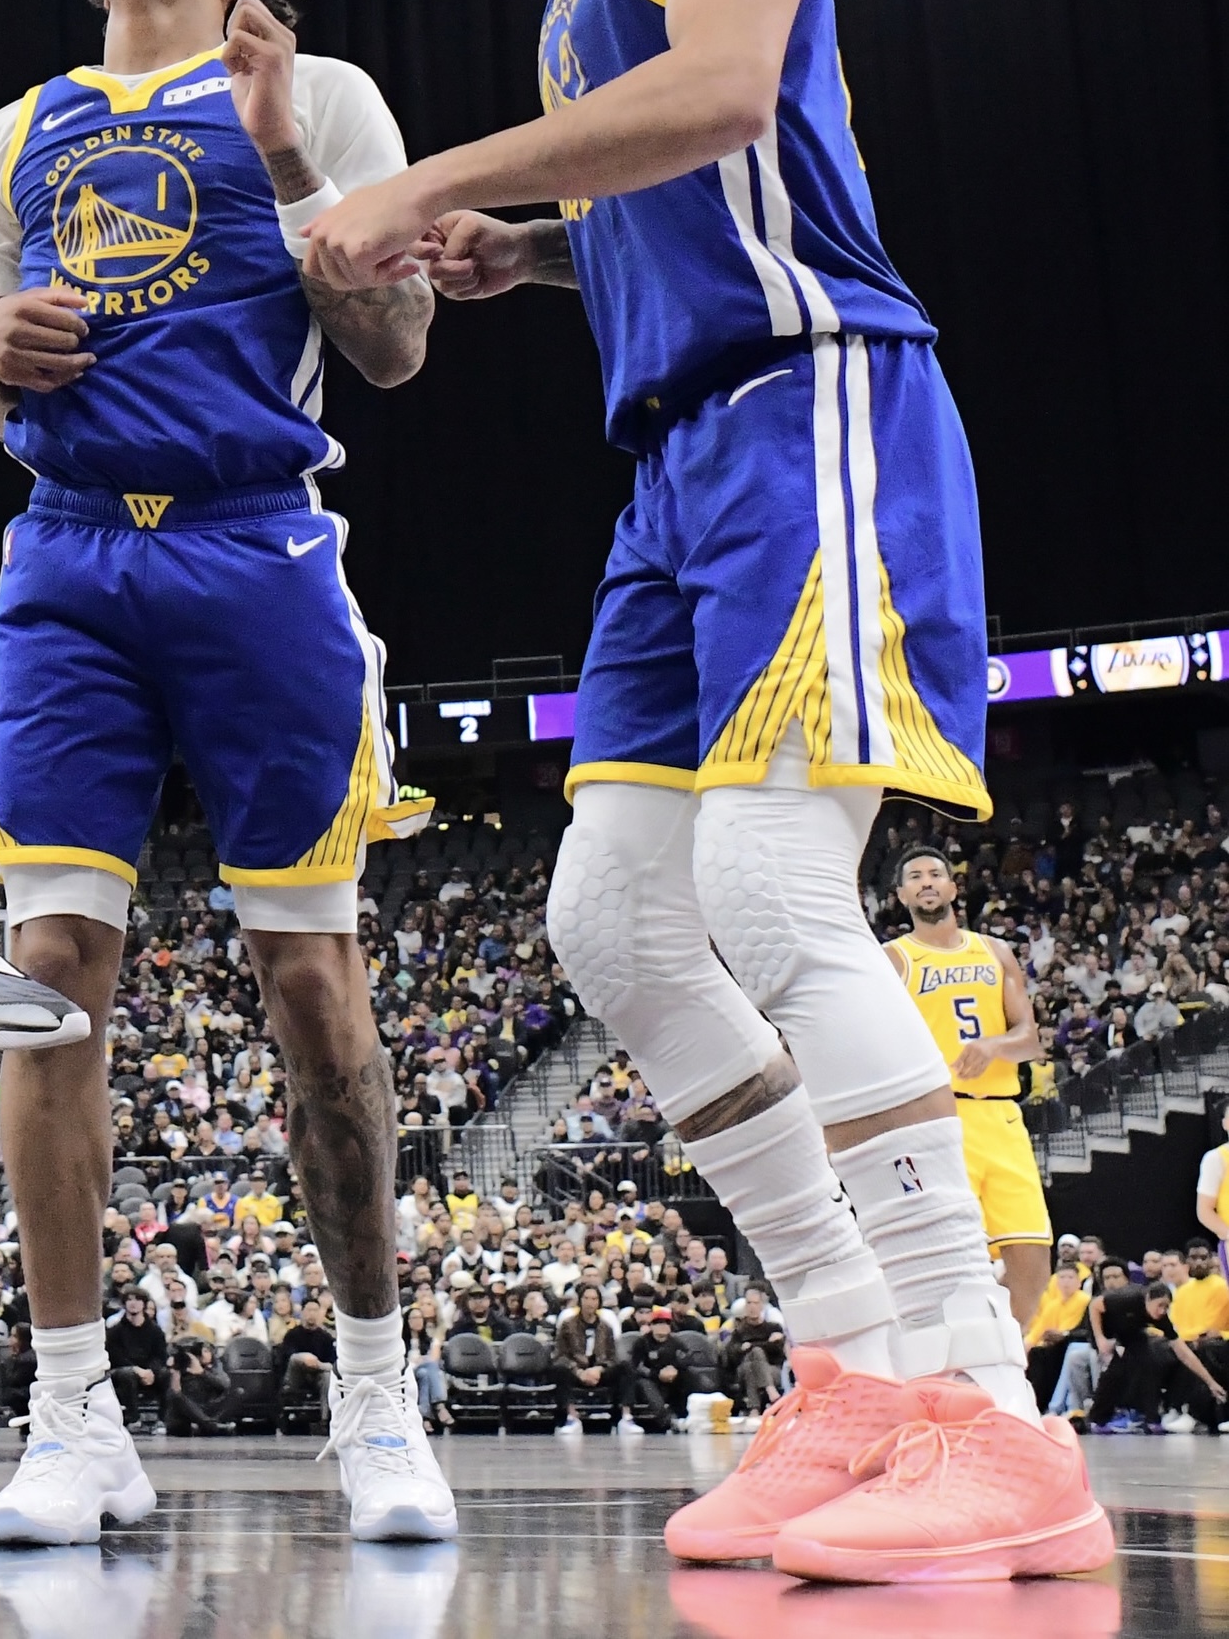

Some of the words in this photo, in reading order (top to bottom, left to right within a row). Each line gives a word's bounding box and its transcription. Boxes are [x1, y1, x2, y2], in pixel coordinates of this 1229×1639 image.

[169, 79, 226, 103] IREN
[45, 125, 132, 187] GOLDEN
[142, 125, 206, 162] STATE
[157, 171, 167, 212] 1
[50, 251, 211, 316] RRIORS
[122, 493, 174, 529] W
[460, 717, 479, 743] 2
[917, 965, 997, 996] LAKERS
[954, 997, 981, 1040] 5
